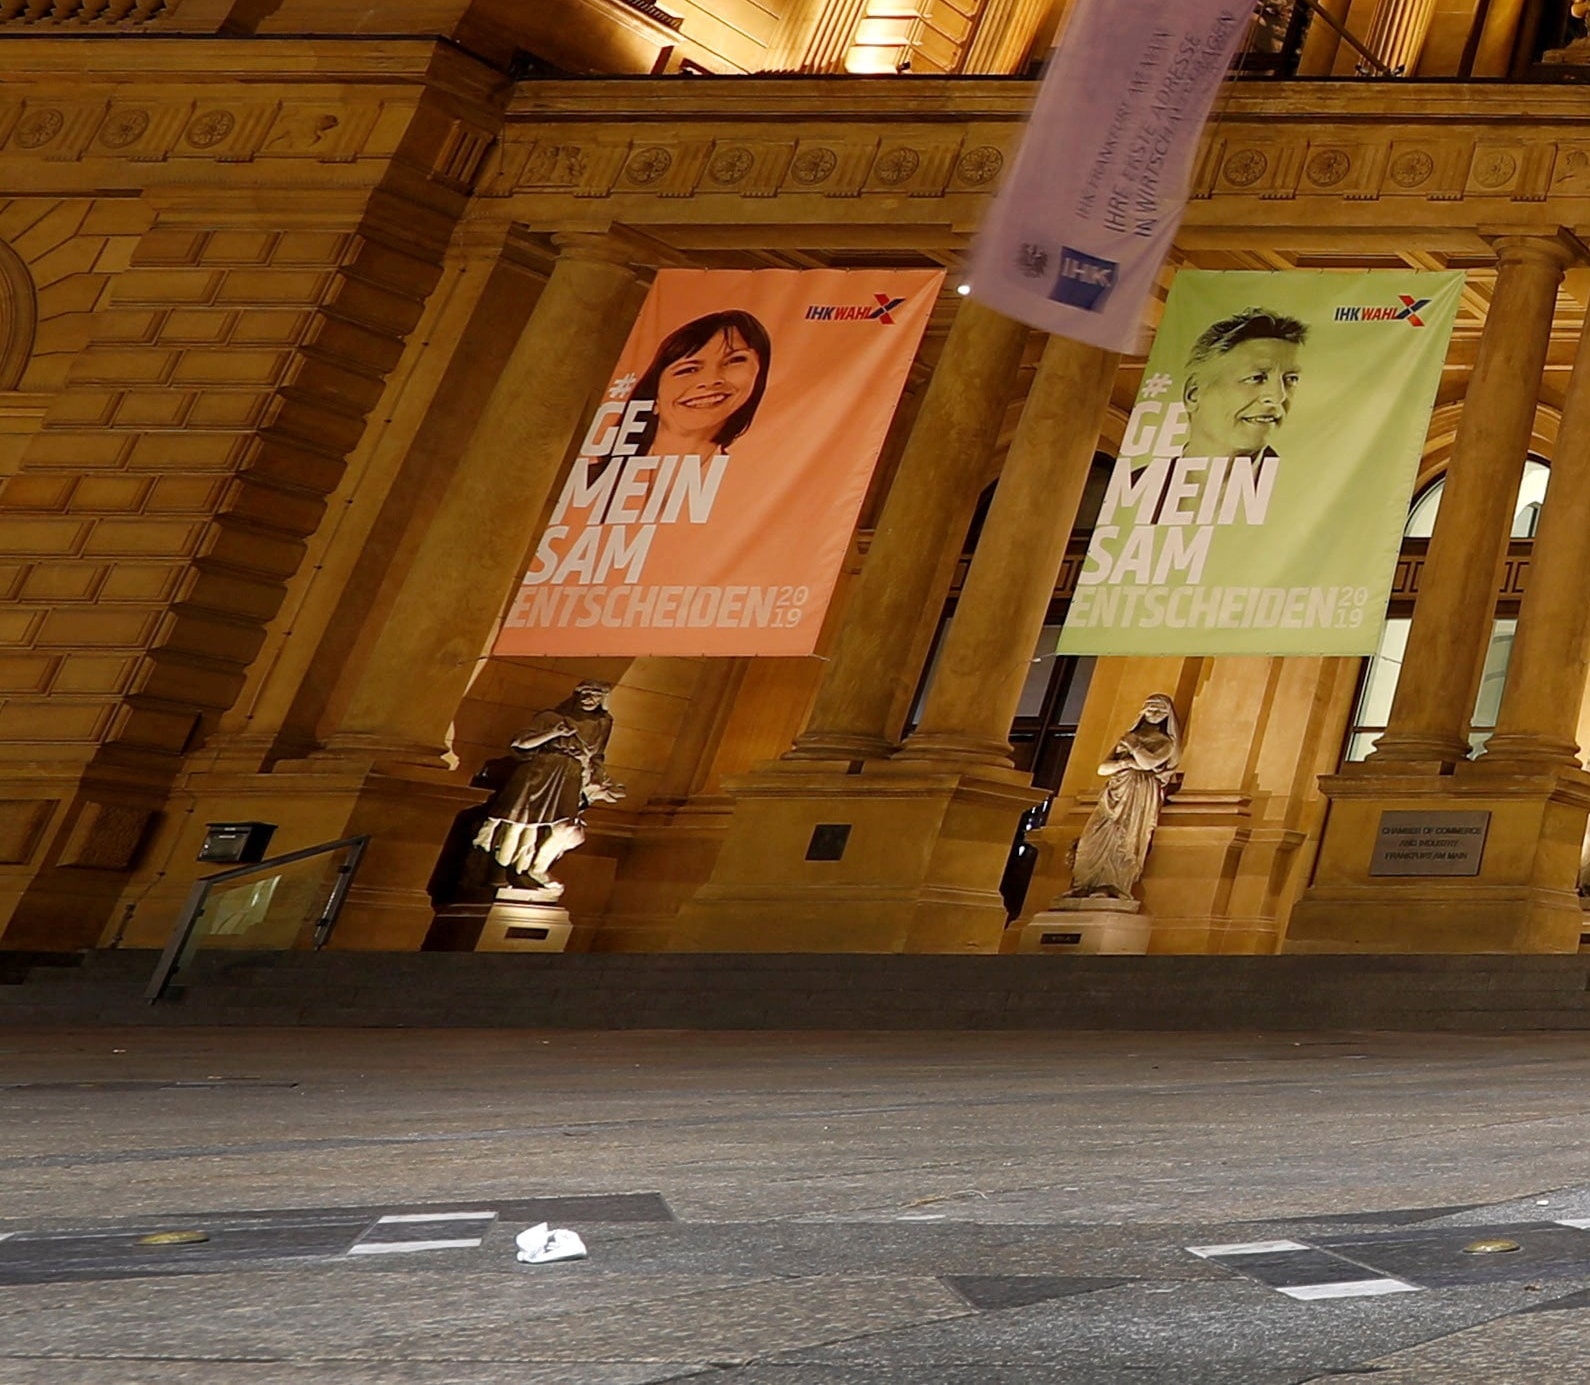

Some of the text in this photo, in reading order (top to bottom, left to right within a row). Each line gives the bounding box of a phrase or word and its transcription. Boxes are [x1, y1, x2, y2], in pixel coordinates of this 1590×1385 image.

[1152, 31, 1201, 121] ADRESSE
[1061, 257, 1113, 287] IHK
[579, 399, 655, 457] GE
[1120, 401, 1190, 457] GE
[549, 454, 730, 525] MEIN
[1100, 456, 1280, 525] MEIN
[521, 525, 657, 585] SAM
[1079, 525, 1213, 585] SAM
[504, 586, 778, 628] ENTSCHEIDEN
[1066, 586, 1339, 628] ENTSCHEIDEN
[1422, 827, 1435, 835] OF
